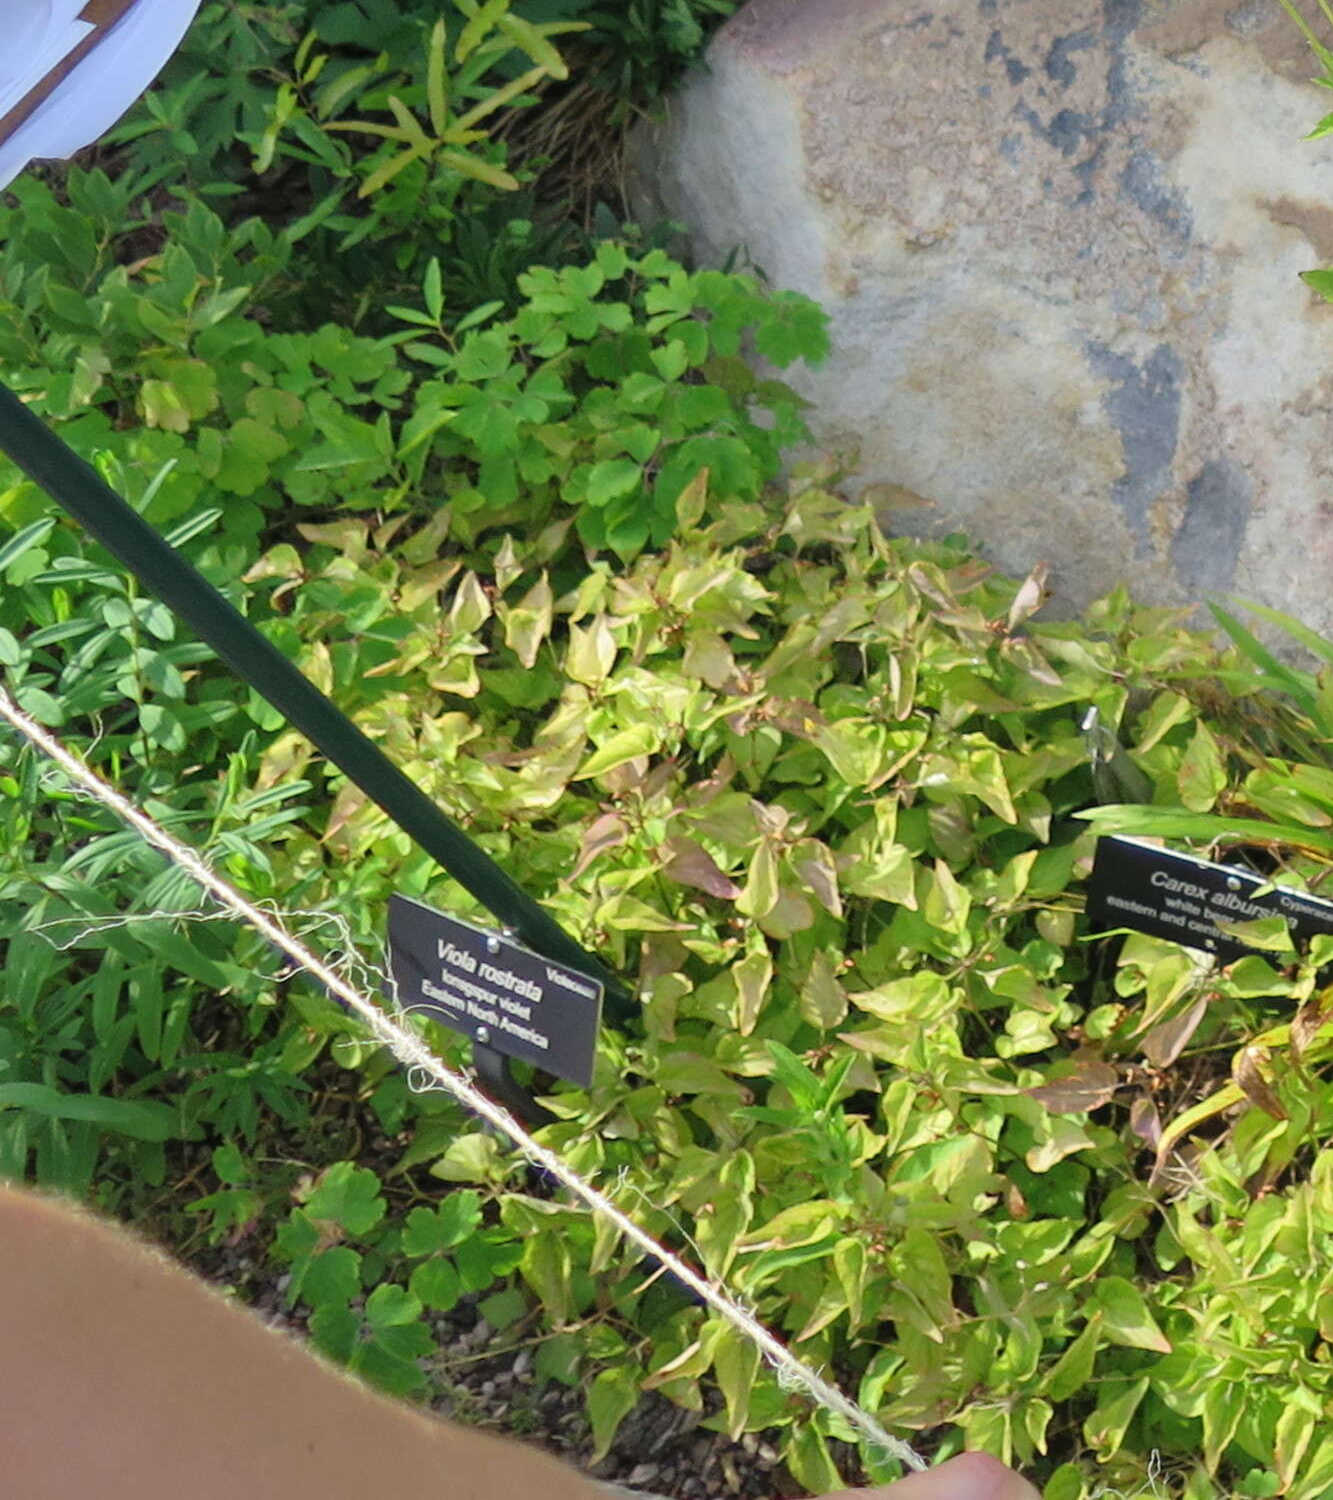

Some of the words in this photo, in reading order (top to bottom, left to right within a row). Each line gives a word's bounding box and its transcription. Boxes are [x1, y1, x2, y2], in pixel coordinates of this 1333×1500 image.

[1106, 895, 1158, 919] eastern
[1159, 911, 1187, 927] and
[1150, 871, 1209, 899] Carex
[1210, 891, 1299, 930] albursia
[1165, 897, 1201, 916] white
[438, 938, 478, 974] Viola
[478, 963, 543, 1003] rostrata
[421, 979, 466, 1011] Eastern
[467, 1000, 501, 1027] North
[500, 1016, 550, 1050] America
[499, 997, 532, 1022] violet
